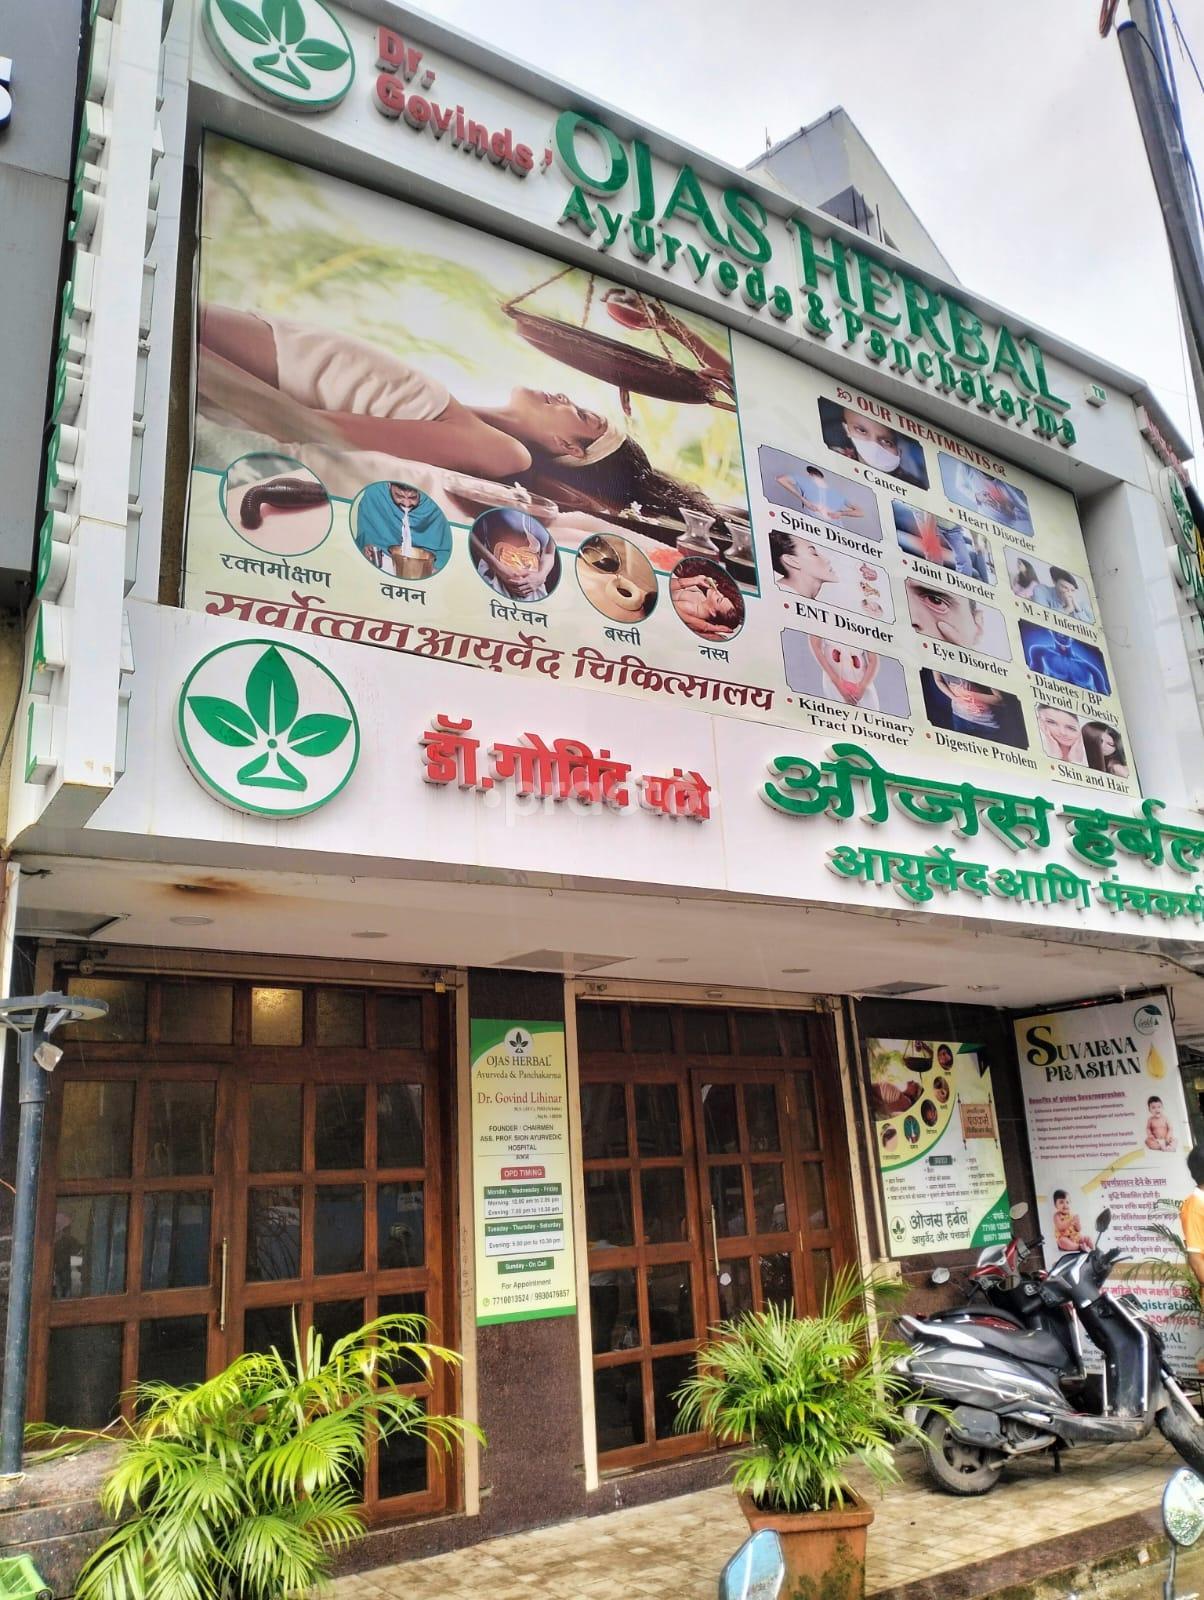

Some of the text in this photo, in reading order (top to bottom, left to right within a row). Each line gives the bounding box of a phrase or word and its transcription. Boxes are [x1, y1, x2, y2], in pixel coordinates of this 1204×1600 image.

[376, 26, 435, 84] Dr.
[555, 109, 1072, 411] OJAS HERBAL
[557, 187, 794, 319] Ayurveda
[804, 297, 835, 338] &
[843, 310, 1078, 448] Panchakarma
[856, 395, 992, 471] OUR TREATMENTS
[863, 468, 908, 497] Cancer
[781, 511, 884, 559] Spine Disorder
[958, 508, 1037, 552] Heart Disorder
[219, 553, 331, 588] रक्तमोक्षण
[911, 560, 996, 601] Joint Disorder
[380, 582, 426, 605] वमन
[489, 599, 548, 628] विरेचन
[795, 602, 894, 644] ENT Disorder
[1022, 603, 1035, 616] M
[1052, 611, 1099, 642] Infertility
[205, 591, 414, 650] सर्वोत्तम
[572, 646, 775, 711] चिकित्सालय
[604, 625, 642, 646] बस्ती
[698, 644, 730, 663] नस्य
[933, 644, 1009, 677] Eye Disorder
[1035, 674, 1081, 699] Diabetes
[799, 697, 850, 722] Kidney
[863, 712, 915, 736] Urinary
[1031, 686, 1070, 713] Thyroid
[1082, 701, 1120, 725] Obesity
[808, 712, 910, 748] Tract Disorder
[935, 732, 1038, 771] Digestive Problem
[1058, 765, 1130, 794] Skin and Hair
[829, 845, 989, 903] आयुर्वेद
[993, 863, 1092, 909] आणि
[486, 1055, 551, 1067] OJAS HERBAL
[1026, 1026, 1138, 1066] SUVARNA
[1045, 1057, 1142, 1082] PRASHAN
[478, 1092, 493, 1104] Dr.
[495, 1092, 527, 1104] Govind
[520, 1169, 542, 1177] TIMING
[945, 1206, 969, 1229] हर्बल
[513, 1279, 552, 1289] Appointment
